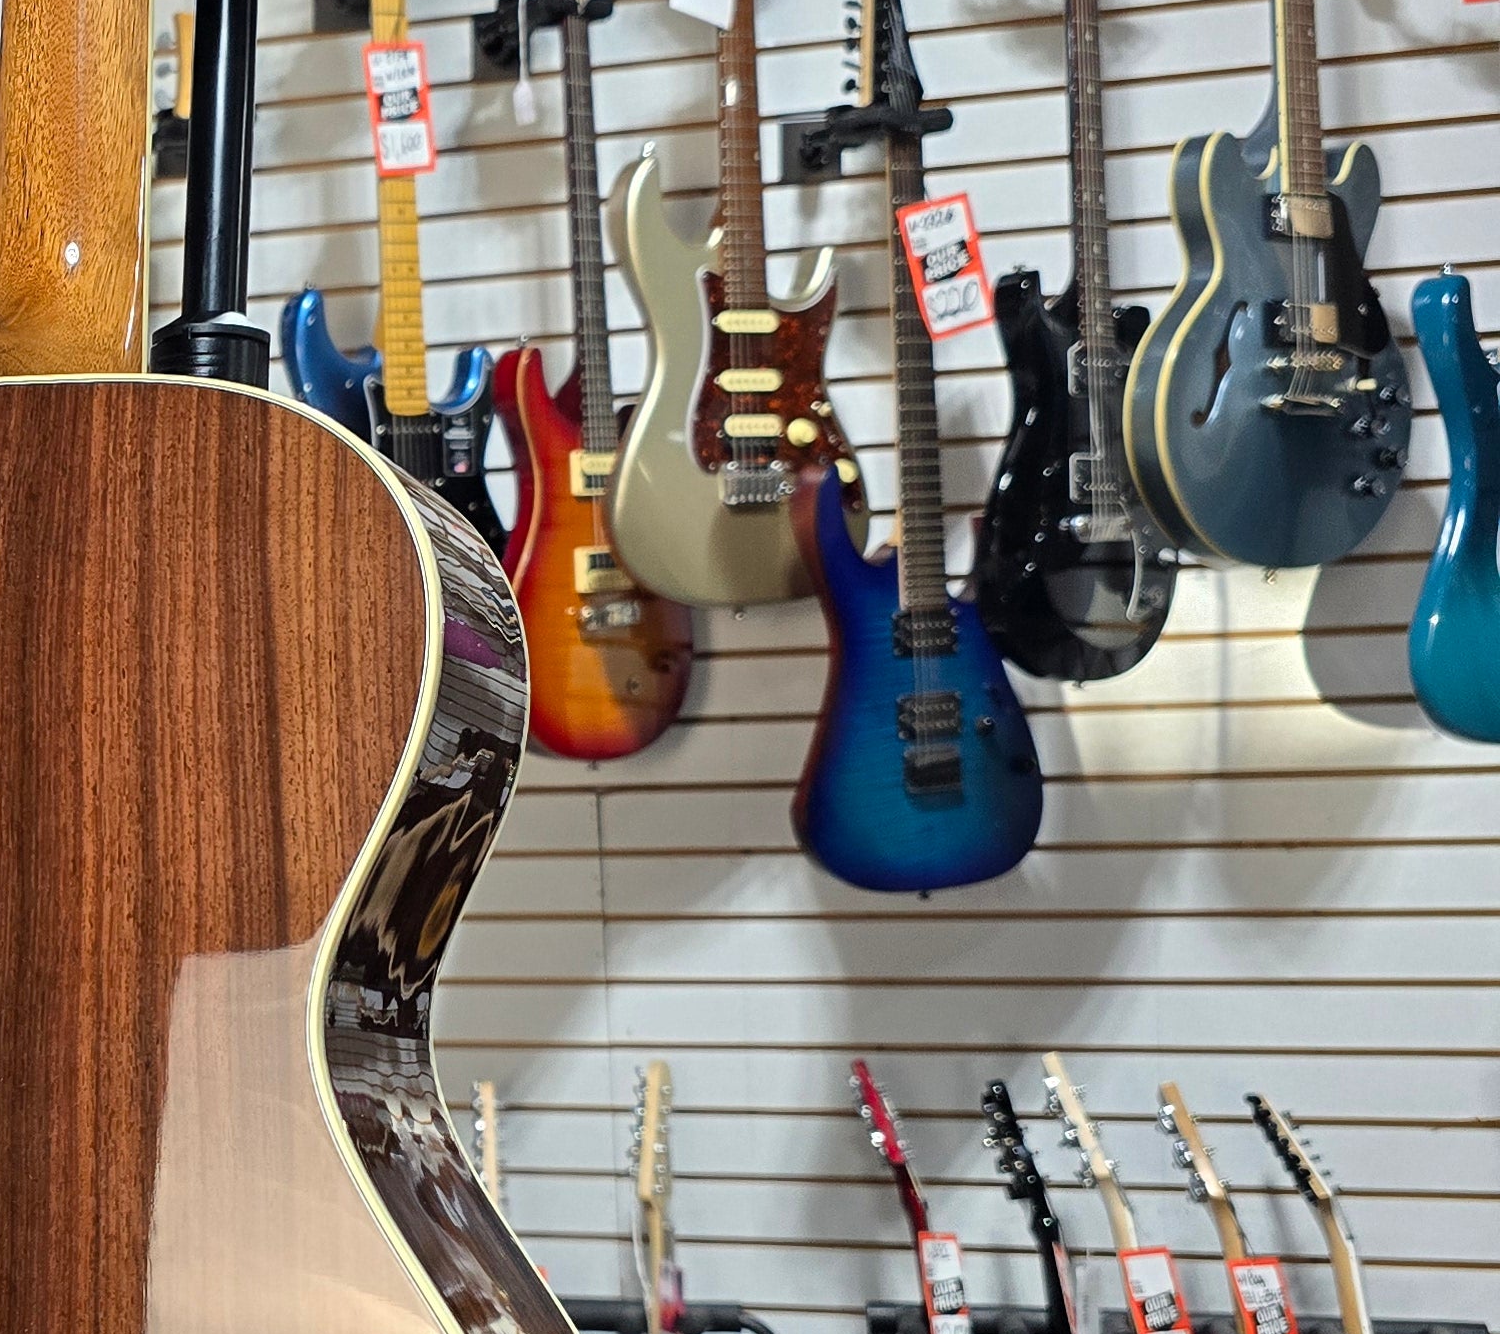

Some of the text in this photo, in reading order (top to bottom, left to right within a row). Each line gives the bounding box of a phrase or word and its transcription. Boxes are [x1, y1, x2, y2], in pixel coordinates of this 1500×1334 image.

[925, 241, 961, 269] OUR
[933, 1278, 959, 1298] OUR
[933, 1289, 965, 1314] PRICE
[1144, 1293, 1171, 1314] OUR
[1144, 1304, 1180, 1331] PRICE
[1255, 1306, 1280, 1324] OUR
